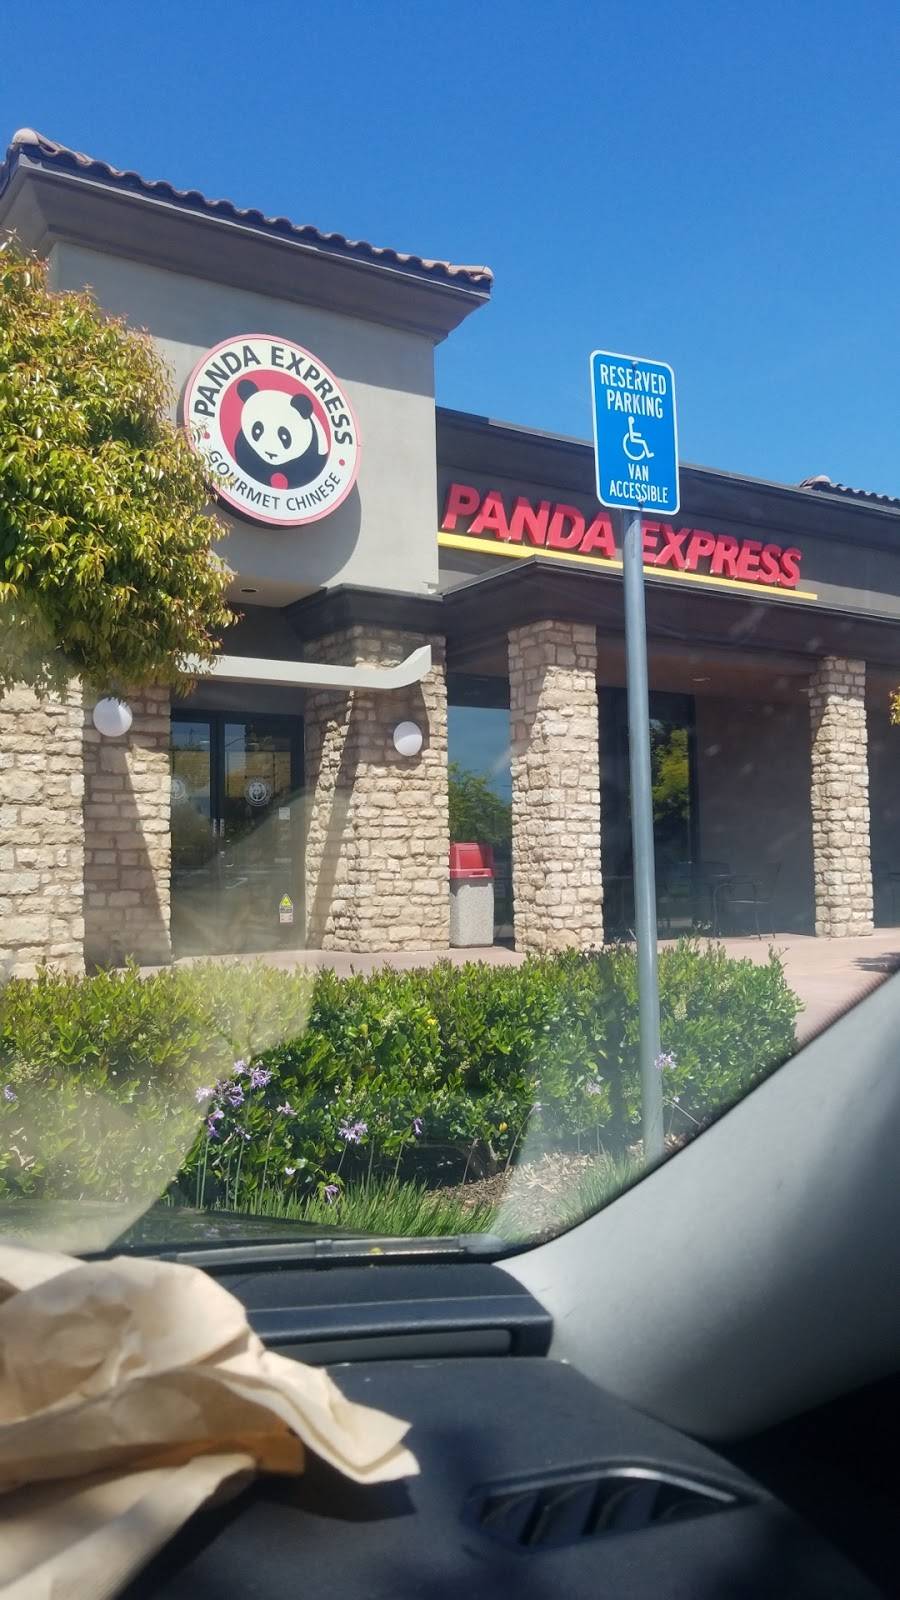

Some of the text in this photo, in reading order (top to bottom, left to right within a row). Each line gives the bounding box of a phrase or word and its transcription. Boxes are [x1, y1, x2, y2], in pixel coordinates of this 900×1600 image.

[194, 345, 353, 445] PANDA EXPRESS
[600, 363, 666, 395] RESERVED
[606, 389, 663, 419] PARKING
[209, 450, 341, 511] GORMET CHINESE
[628, 463, 649, 482] VAN
[609, 479, 668, 503] ACCESSIBLE
[441, 484, 802, 588] PANDA EXPRESS
